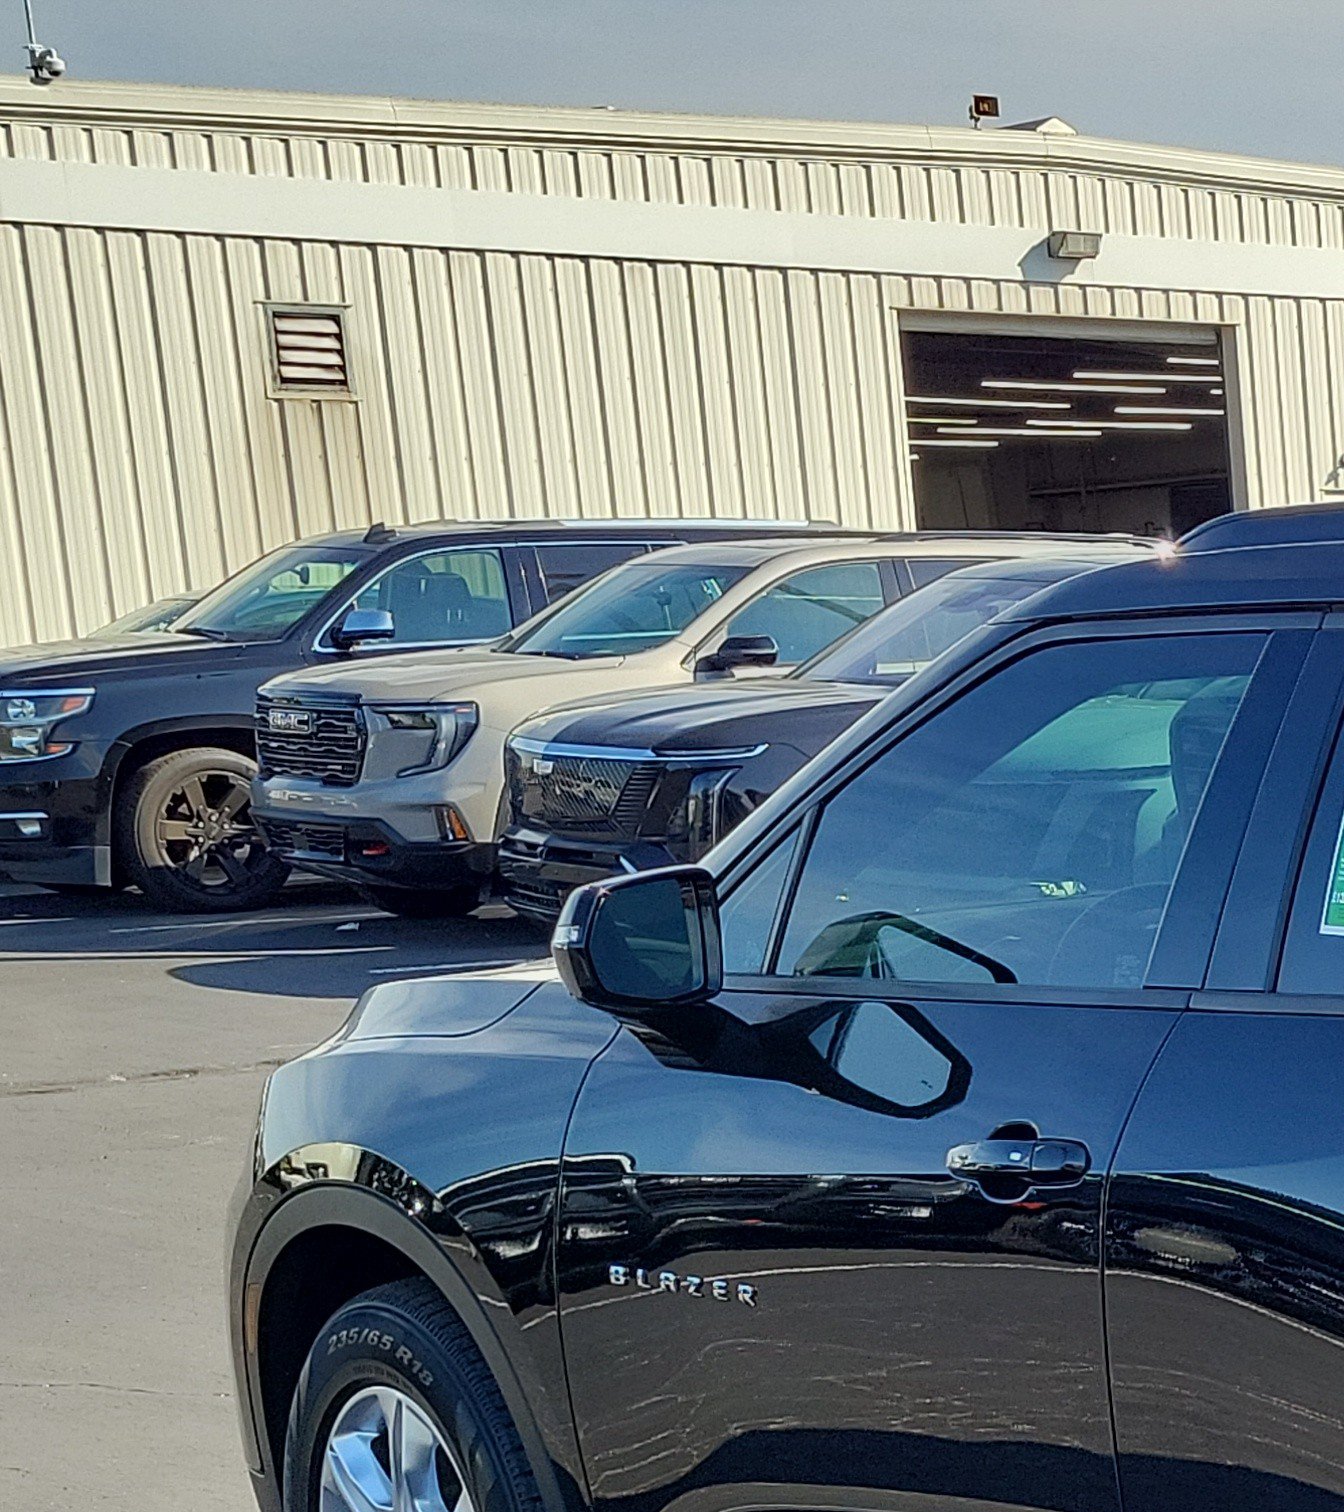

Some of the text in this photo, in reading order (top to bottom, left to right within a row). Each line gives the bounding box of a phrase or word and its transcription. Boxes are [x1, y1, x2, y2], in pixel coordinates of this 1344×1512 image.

[606, 1262, 759, 1307] BLAZER
[326, 1326, 394, 1356] 235/65
[394, 1344, 434, 1387] R18
